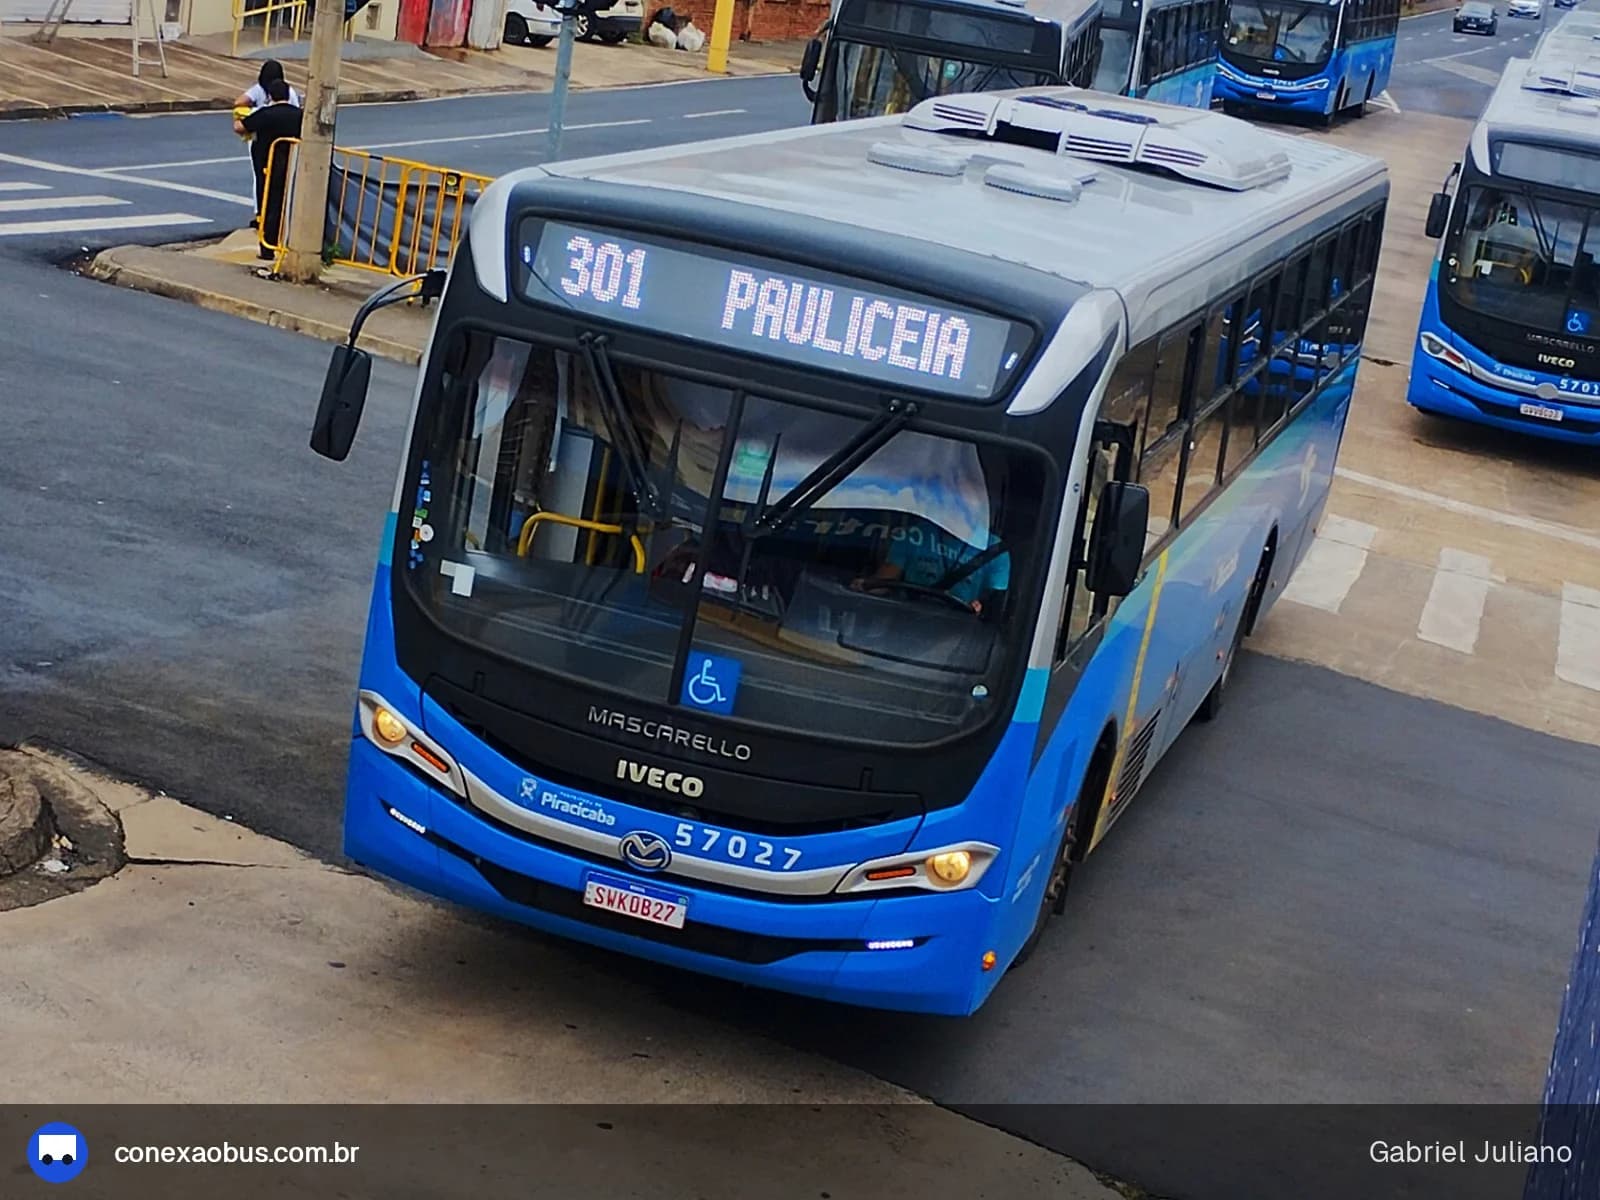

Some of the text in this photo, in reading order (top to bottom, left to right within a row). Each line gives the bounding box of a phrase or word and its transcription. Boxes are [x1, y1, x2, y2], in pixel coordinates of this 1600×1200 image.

[560, 236, 971, 379] 301 PAULICEIA
[1538, 353, 1575, 368] IVECO
[588, 705, 751, 761] MASCARELLO
[616, 760, 704, 798] IVECO
[541, 791, 616, 826] Piracicaba
[675, 823, 802, 870] 57027
